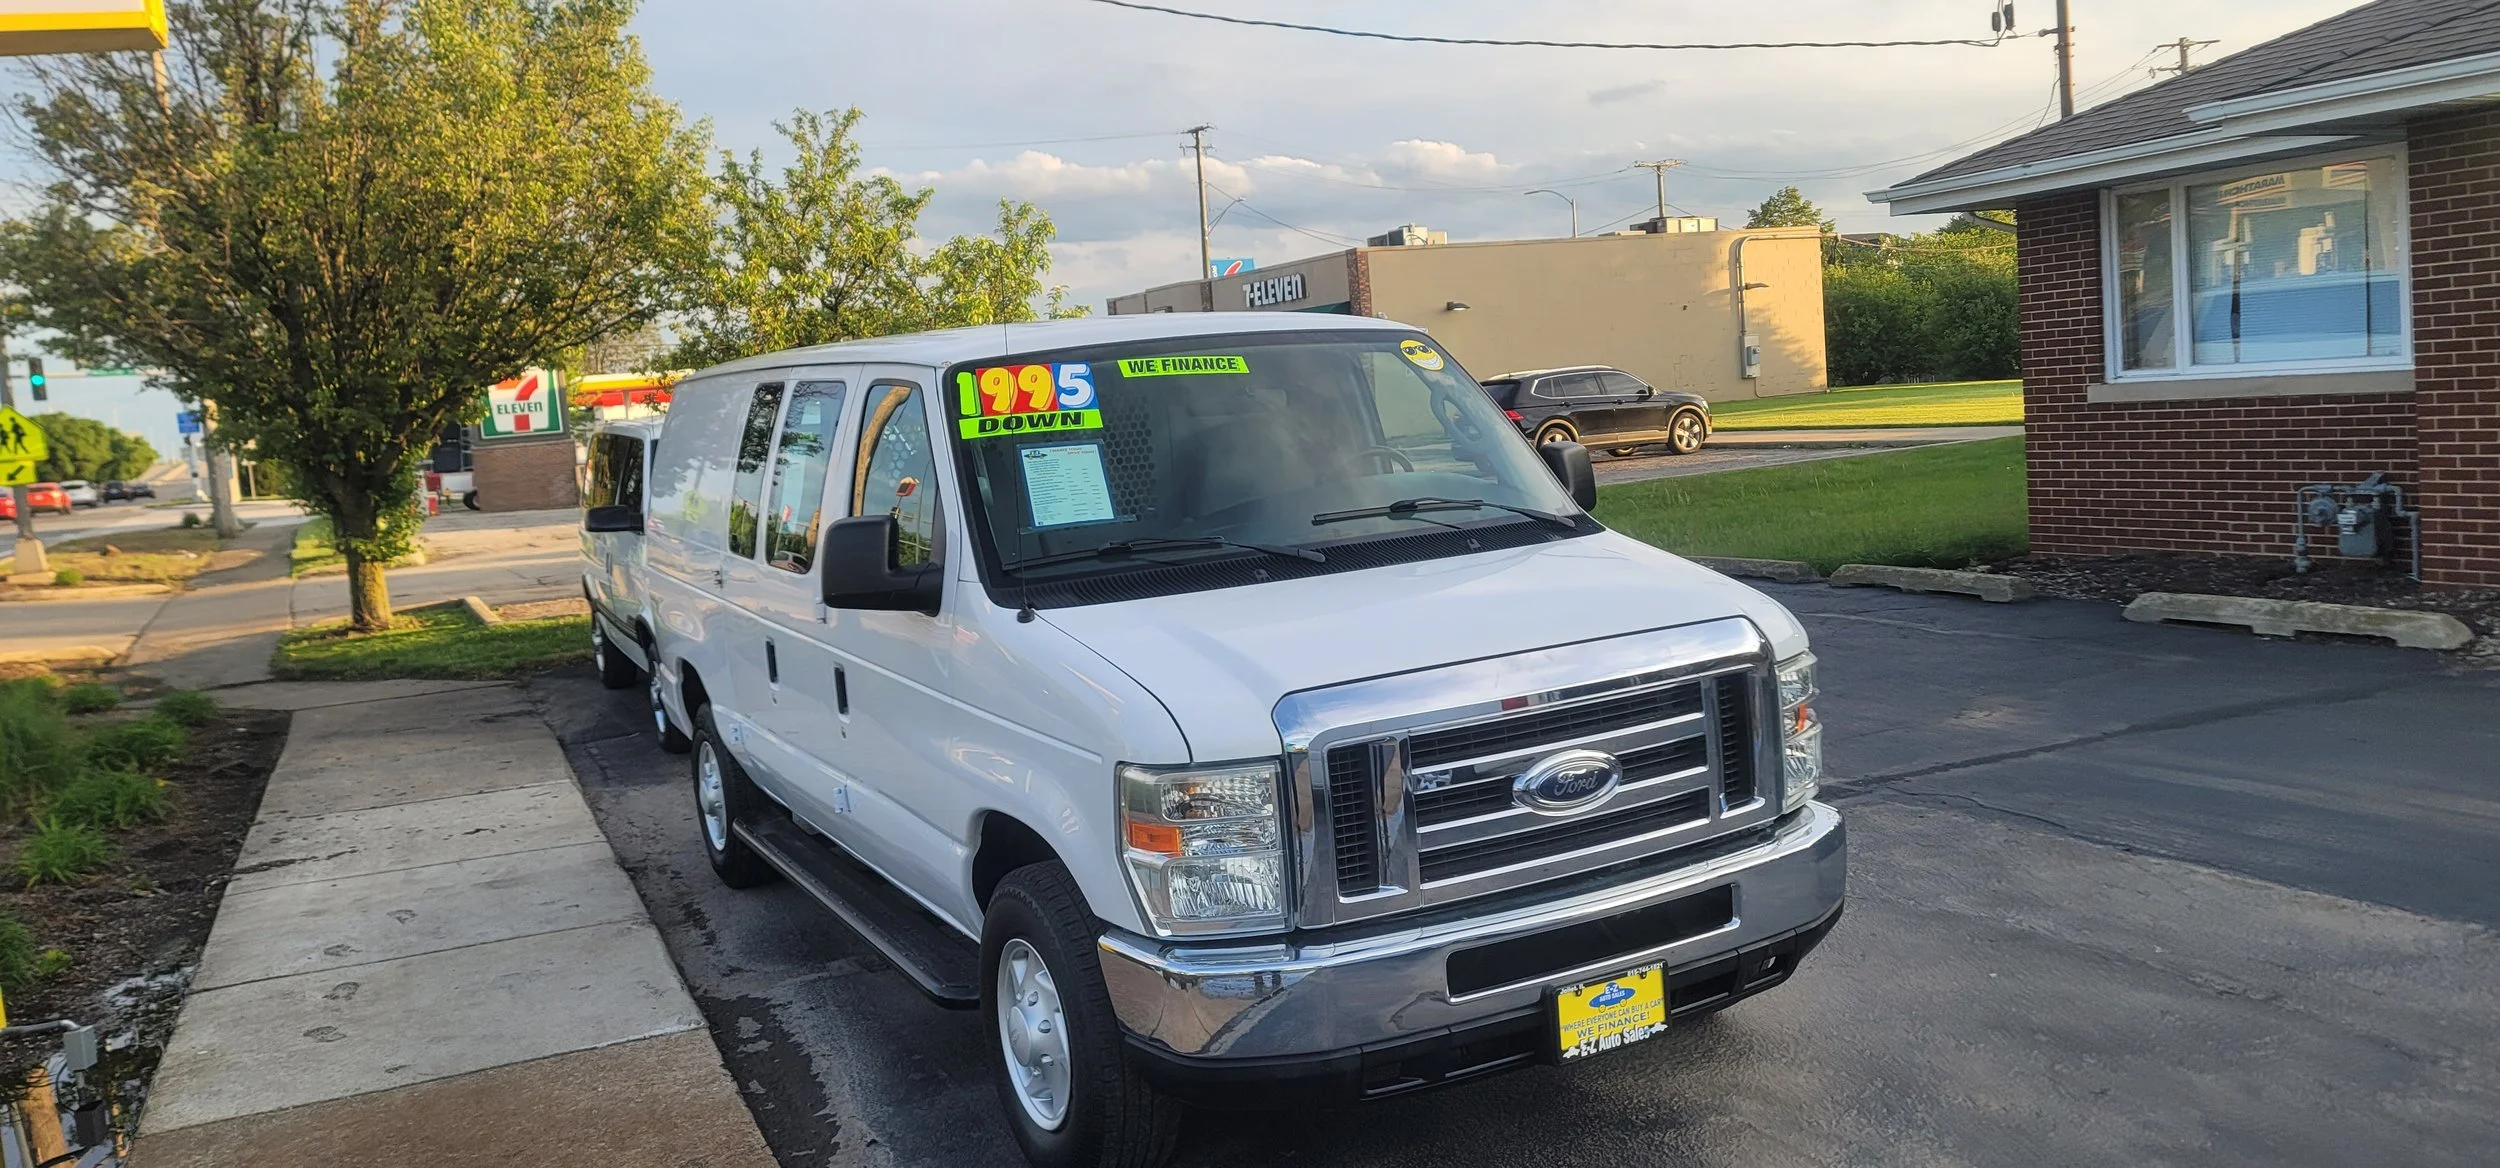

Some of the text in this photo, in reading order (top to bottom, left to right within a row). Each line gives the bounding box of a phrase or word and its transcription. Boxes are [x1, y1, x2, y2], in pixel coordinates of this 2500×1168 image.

[1128, 357, 1239, 374] WE FINANCE
[957, 363, 1095, 417] 1995
[978, 412, 1085, 433] DOWN
[1554, 768, 1599, 796] Ford
[1577, 1011, 1650, 1039] WE FINANCE!
[1587, 1012, 1617, 1026] EVERYONE
[1618, 1008, 1630, 1017] CAN
[1631, 1003, 1643, 1014] BUY
[1580, 1024, 1650, 1057] E-Z Auto Sales
